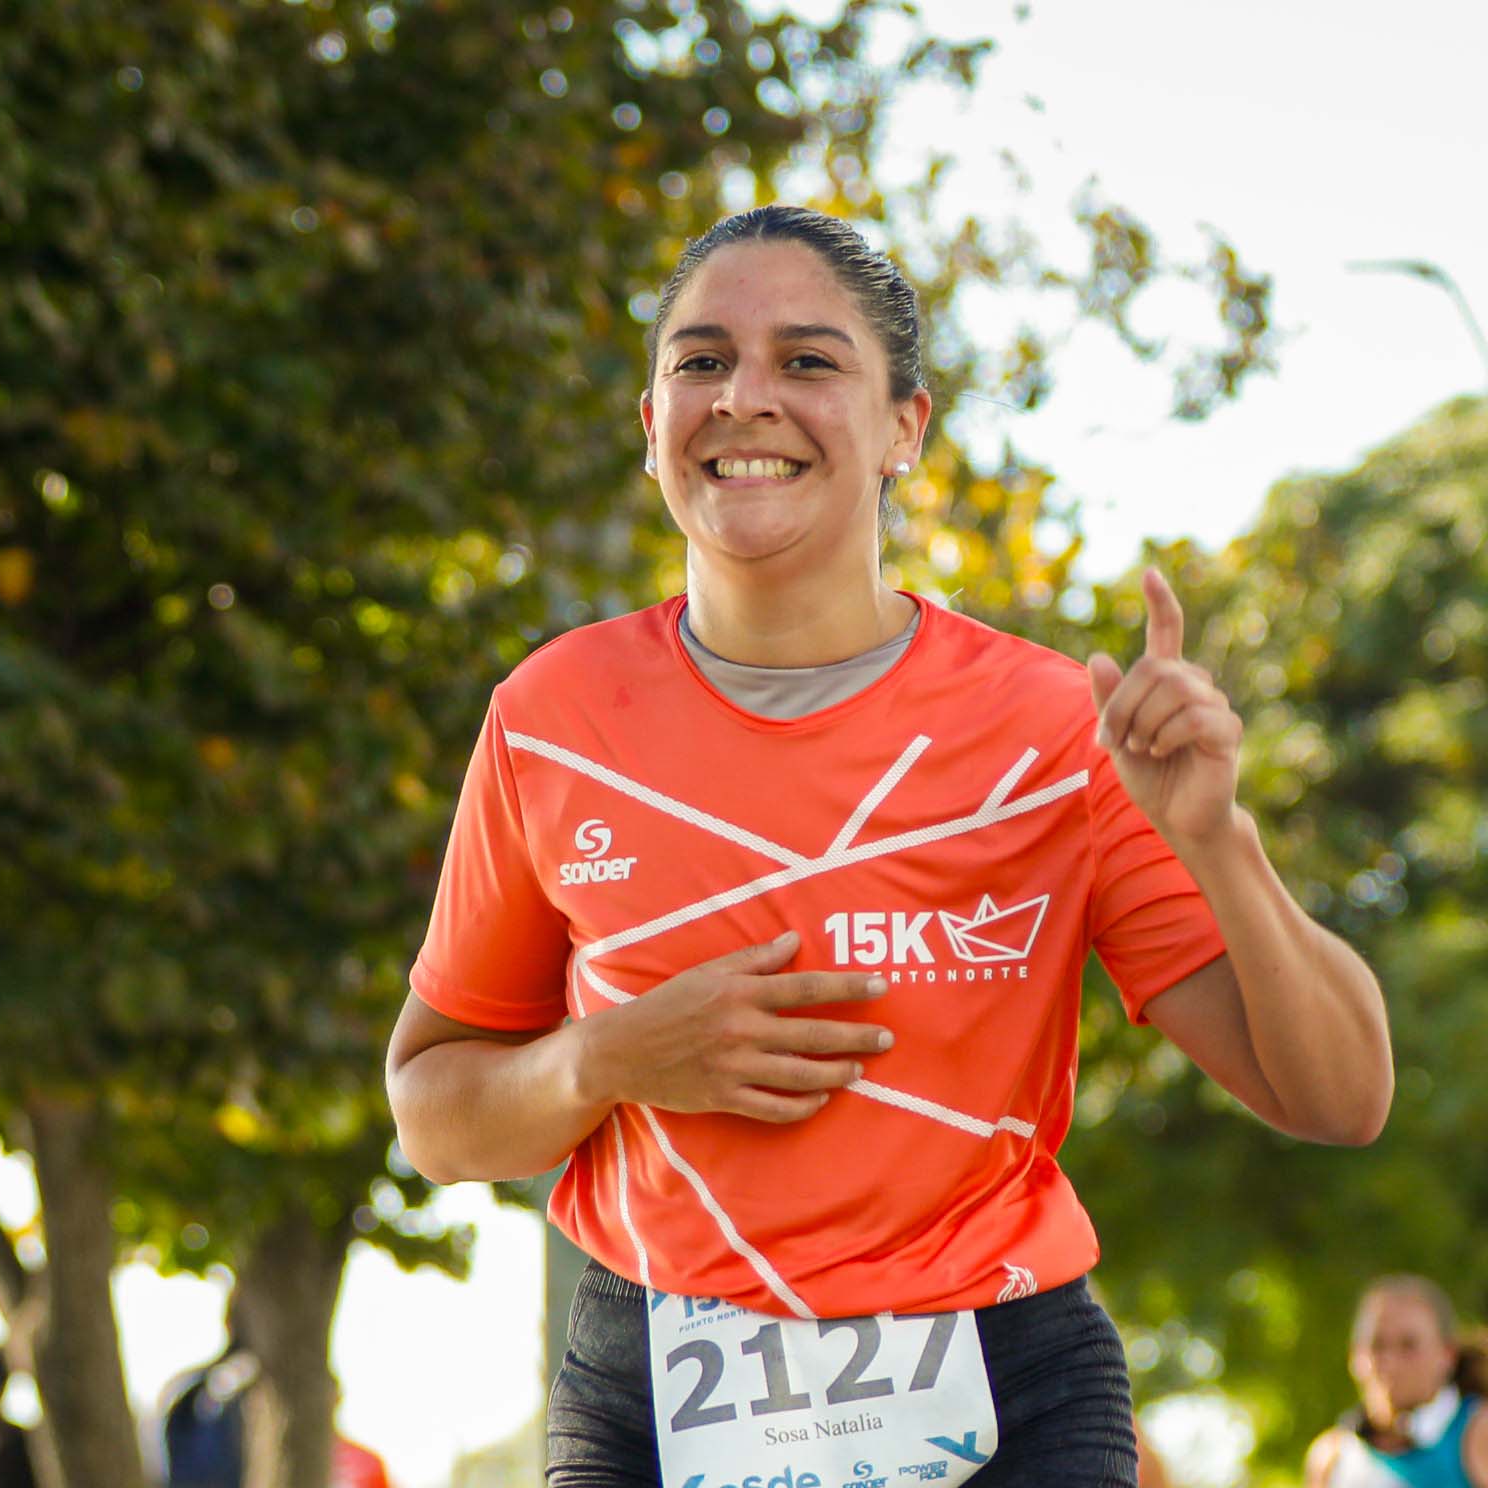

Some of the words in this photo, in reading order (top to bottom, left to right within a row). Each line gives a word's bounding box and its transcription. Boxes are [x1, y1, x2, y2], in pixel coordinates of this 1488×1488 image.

[824, 911, 936, 965] 15K
[873, 969, 936, 984] RTO
[947, 965, 1028, 982] NORTE
[666, 1311, 959, 1433] 2127
[764, 1426, 810, 1446] Sosa
[814, 1412, 884, 1440] Natalia
